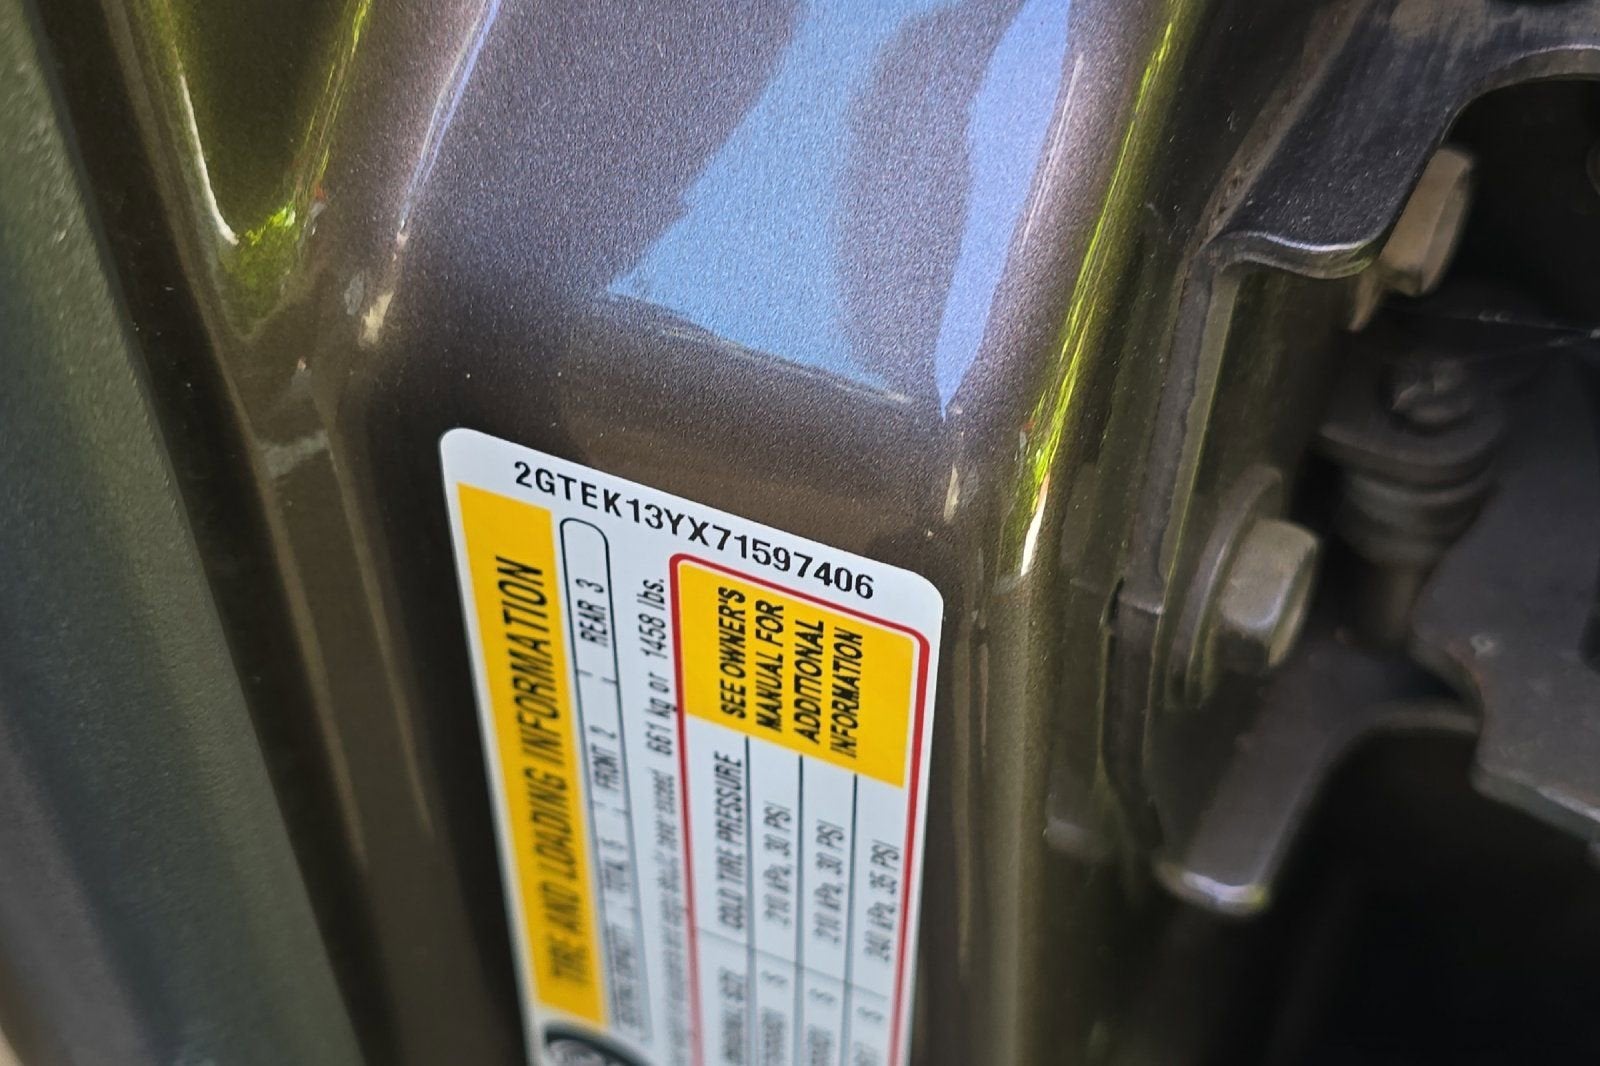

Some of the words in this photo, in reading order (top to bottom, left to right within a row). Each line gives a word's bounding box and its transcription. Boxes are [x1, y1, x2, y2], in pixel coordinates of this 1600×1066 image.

[514, 461, 875, 600] 2GTEK13YX71597406
[575, 577, 604, 593] 3
[637, 578, 665, 610] lbs.
[576, 599, 609, 648] REAR
[637, 613, 668, 659] 1458
[718, 586, 746, 679] OWNER'S
[755, 599, 784, 648] FOR
[495, 555, 565, 767] INFORMATION
[648, 672, 670, 694] or
[794, 619, 825, 746] ADDITIONAL
[645, 697, 677, 719] kg
[720, 678, 746, 719] SEE
[755, 650, 784, 734] MANUAL
[830, 626, 863, 760] INFORMATION
[589, 724, 617, 740] 2
[645, 721, 673, 757] 661
[590, 743, 620, 792] FRONT
[714, 750, 743, 847] PRESSURE
[763, 800, 792, 833] PSI
[524, 767, 577, 881] LOADING
[816, 818, 845, 851] PSI
[715, 847, 744, 885] TIRE
[871, 838, 900, 872] PSI
[717, 887, 744, 931] COLD
